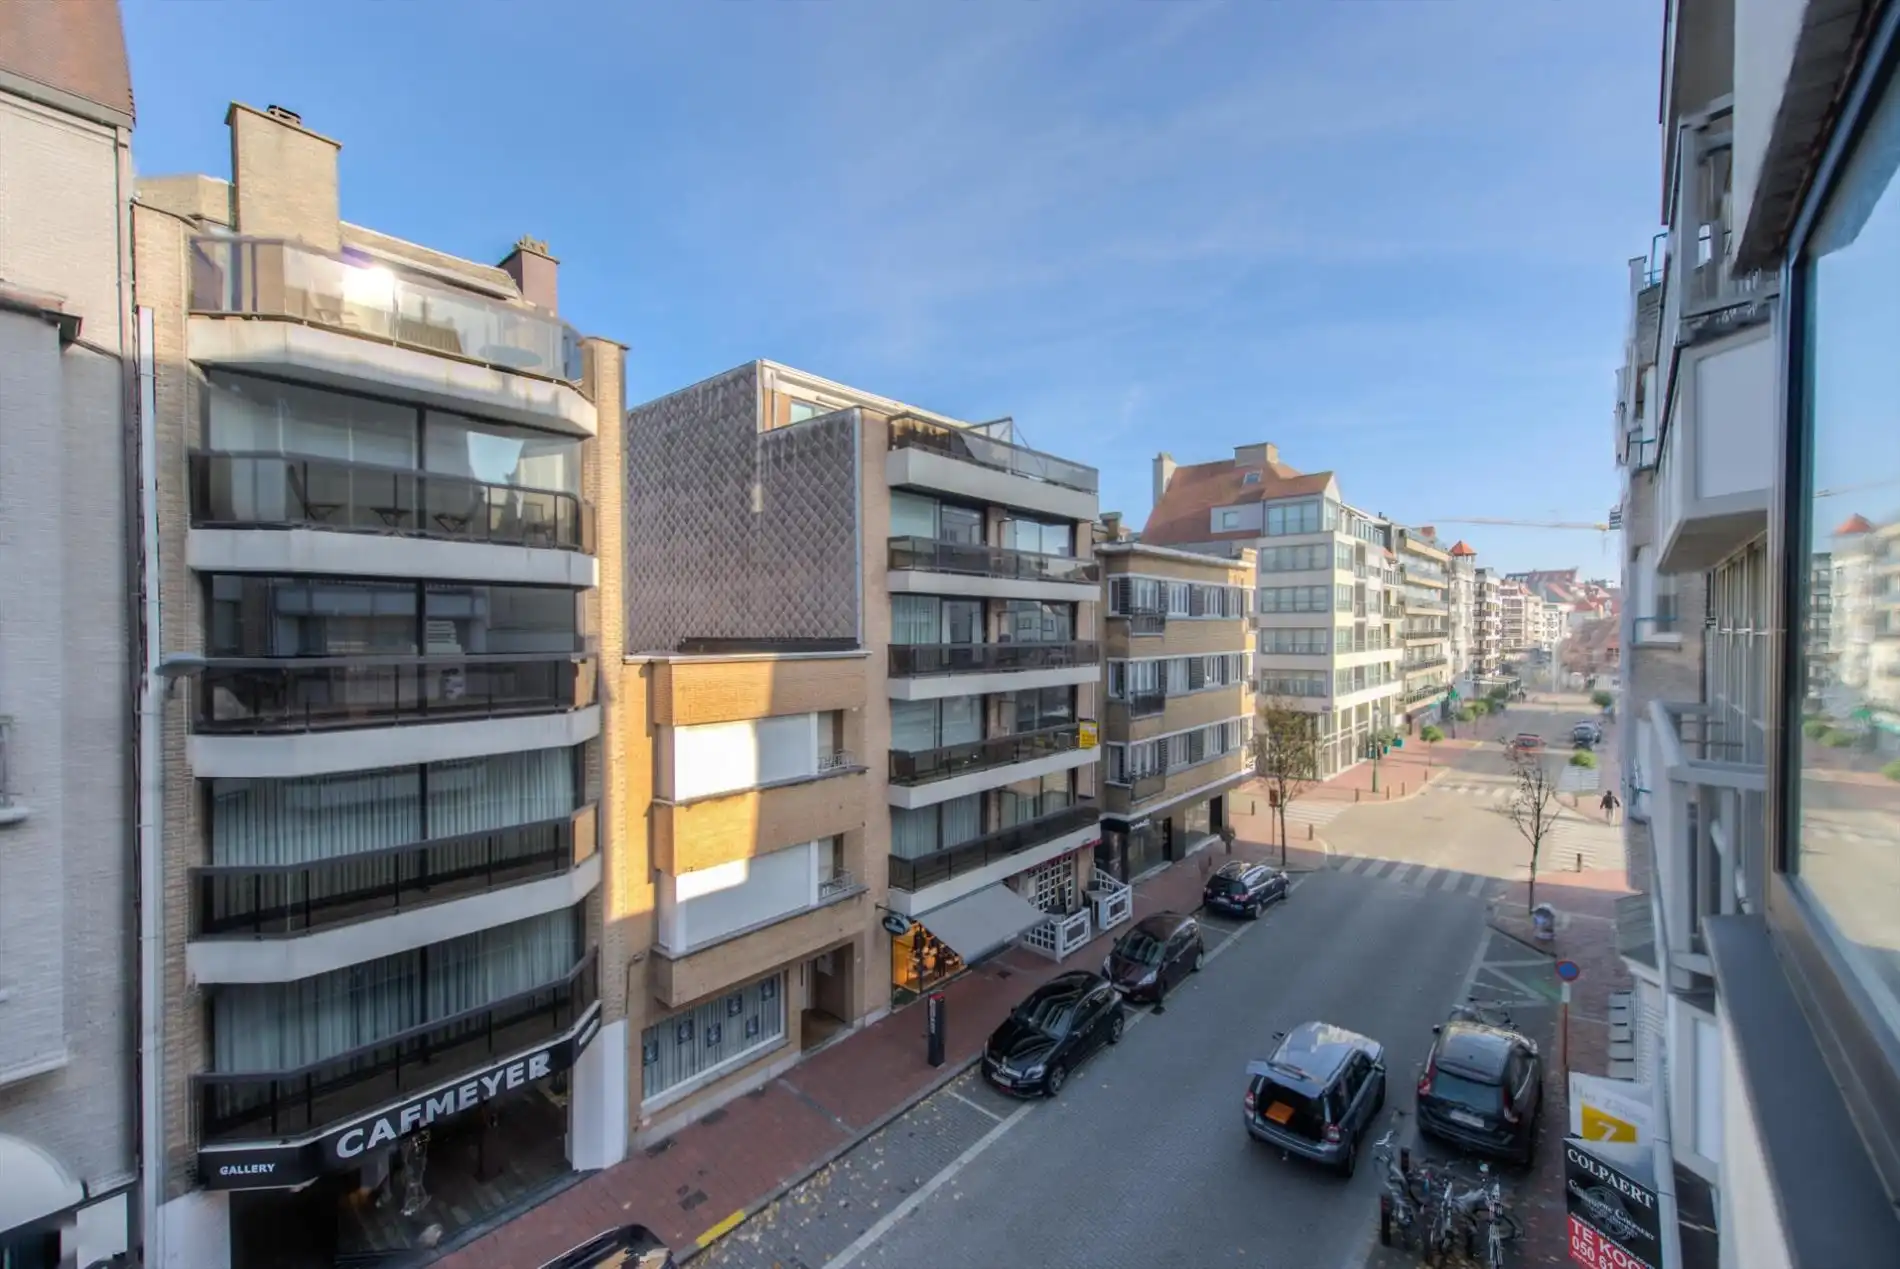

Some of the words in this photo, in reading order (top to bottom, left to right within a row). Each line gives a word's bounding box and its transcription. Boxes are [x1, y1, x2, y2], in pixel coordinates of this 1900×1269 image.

[336, 1049, 551, 1159] CAFMEYER
[219, 1163, 275, 1176] GALLERY
[1567, 1148, 1654, 1209] COLPAERT
[1570, 1218, 1595, 1247] TE
[1571, 1236, 1596, 1262] 050
